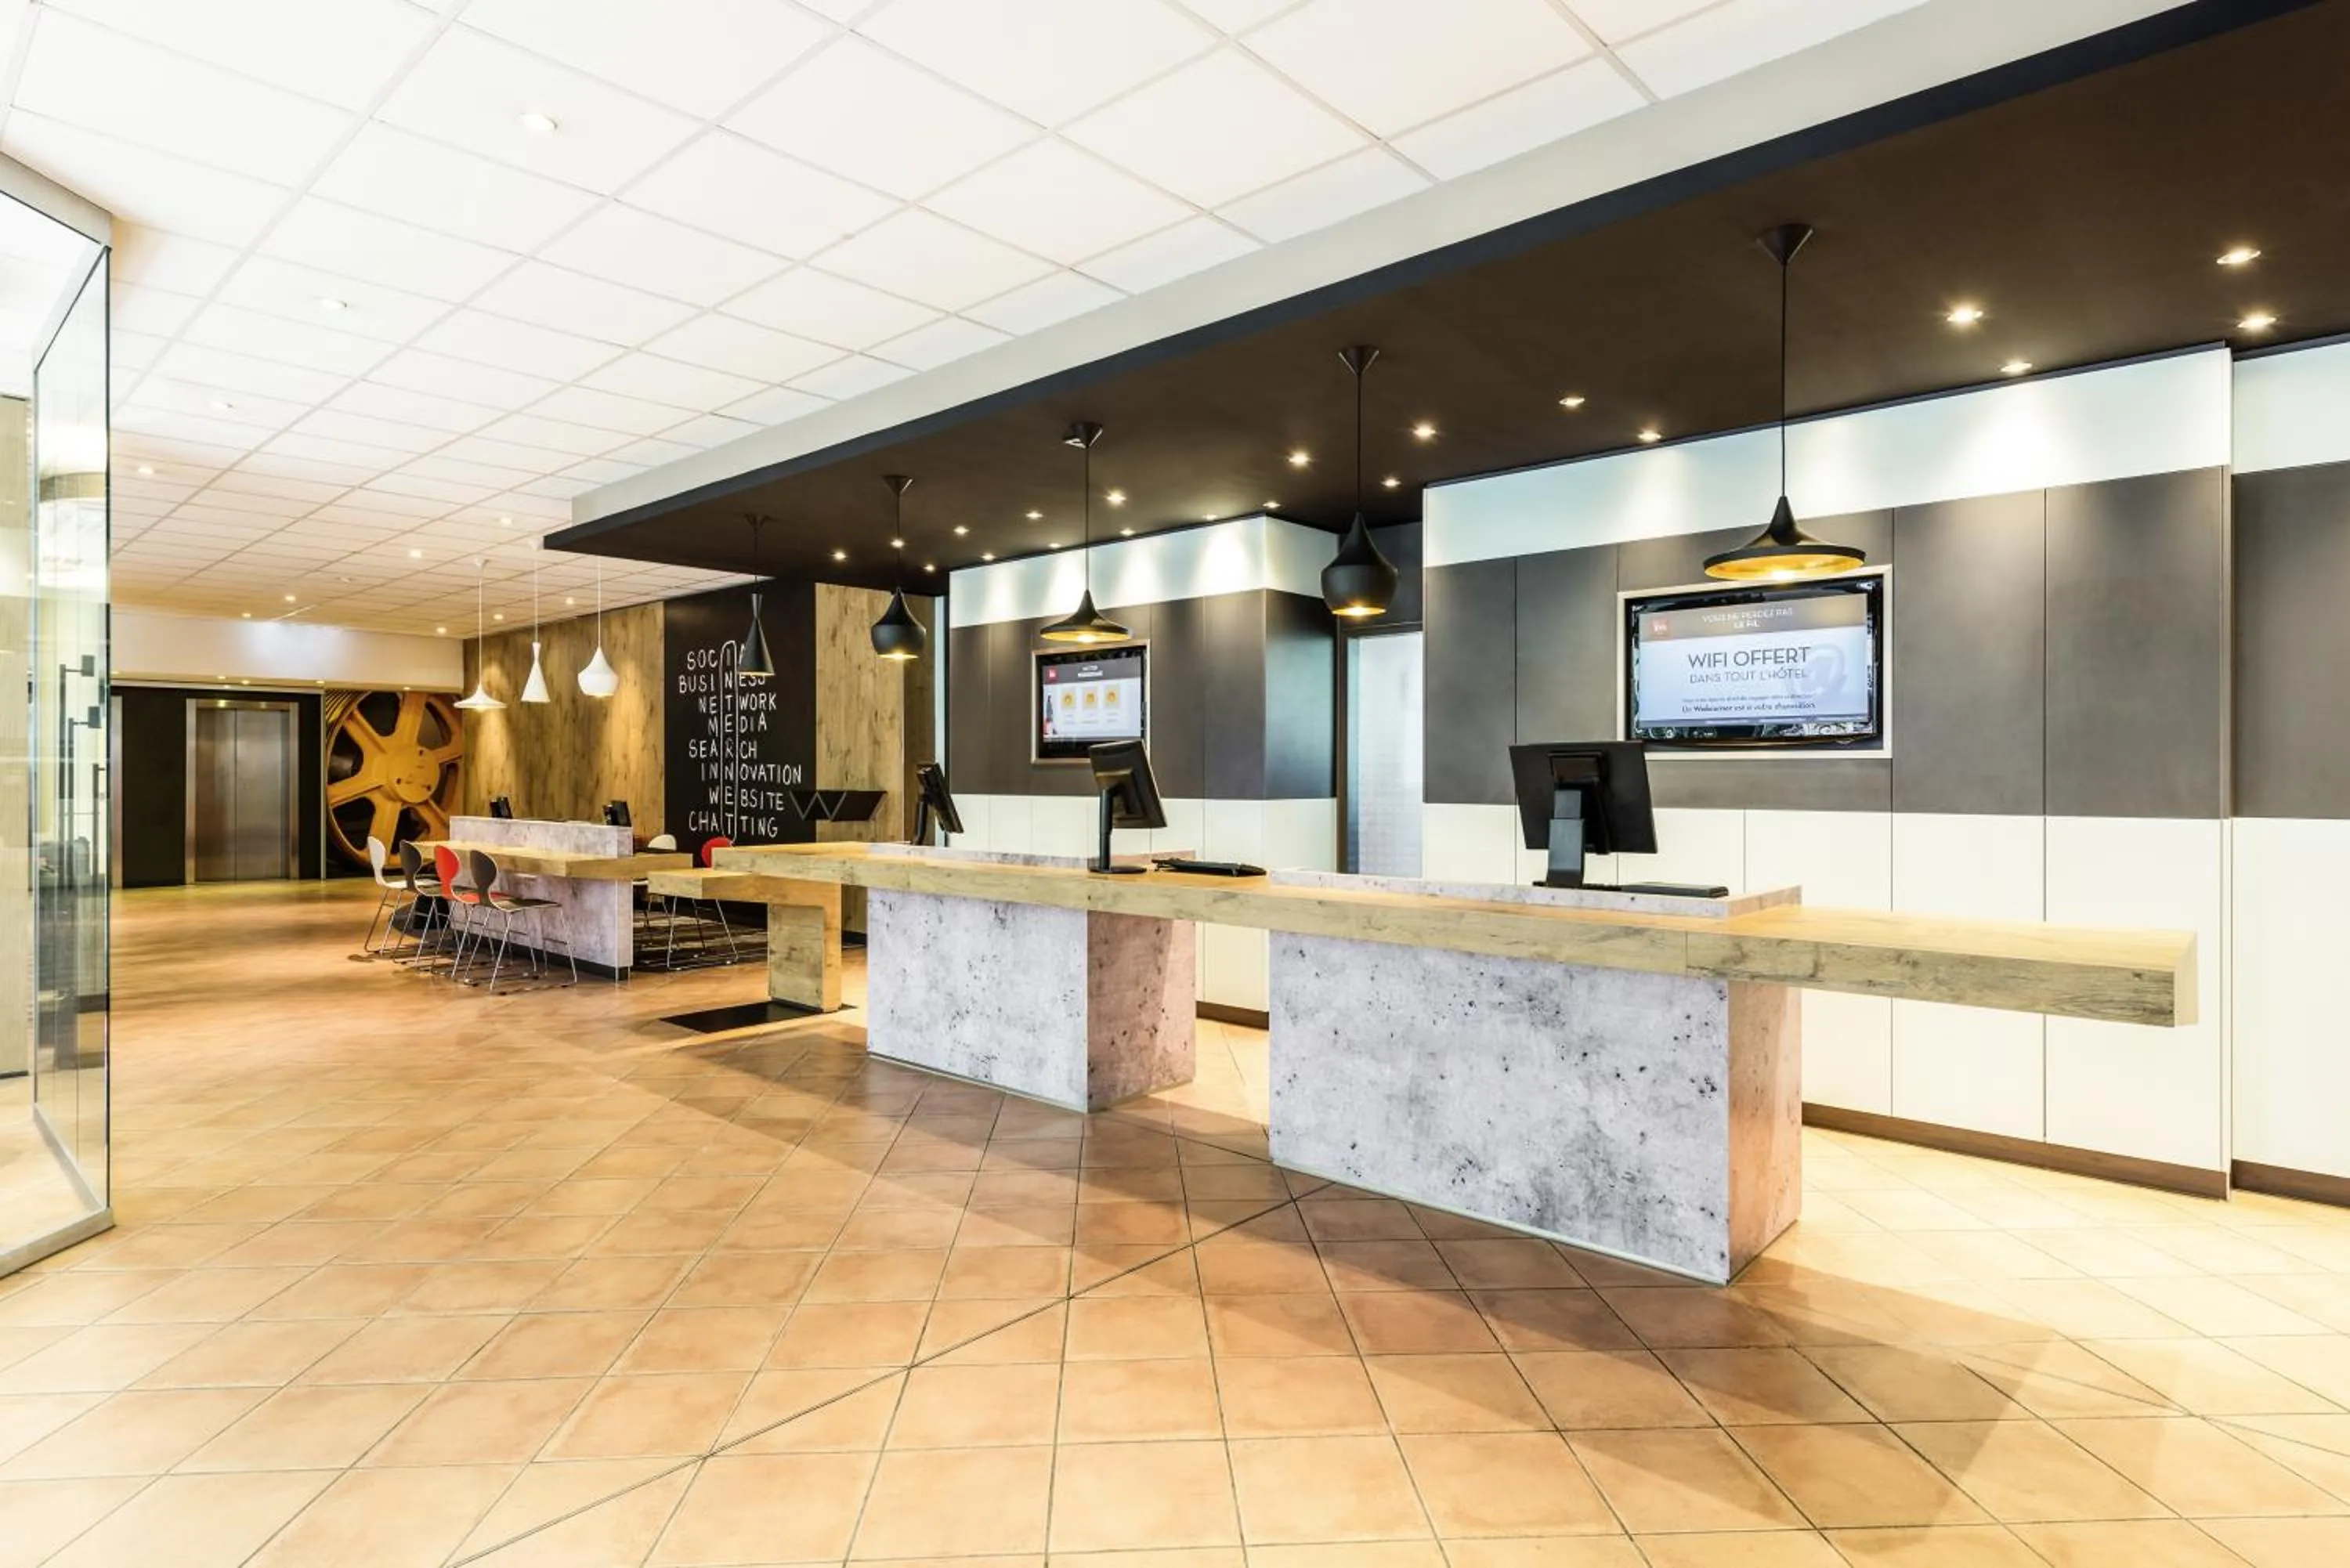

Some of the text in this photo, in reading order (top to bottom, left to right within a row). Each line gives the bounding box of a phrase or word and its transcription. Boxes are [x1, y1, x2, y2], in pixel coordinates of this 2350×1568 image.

[687, 644, 746, 670] SOCI
[1688, 646, 1811, 668] WIFI OFFERT
[678, 670, 765, 694] BUSINESS
[1690, 674, 1721, 684] DANS
[1726, 670, 1755, 681] TOUT
[699, 692, 777, 714] NETWORK
[708, 711, 767, 737] MEDIA
[689, 738, 757, 760] SEARCH
[701, 761, 801, 786] INNOVATION
[709, 786, 784, 811] WEBSITE
[689, 810, 778, 838] CHATTING
